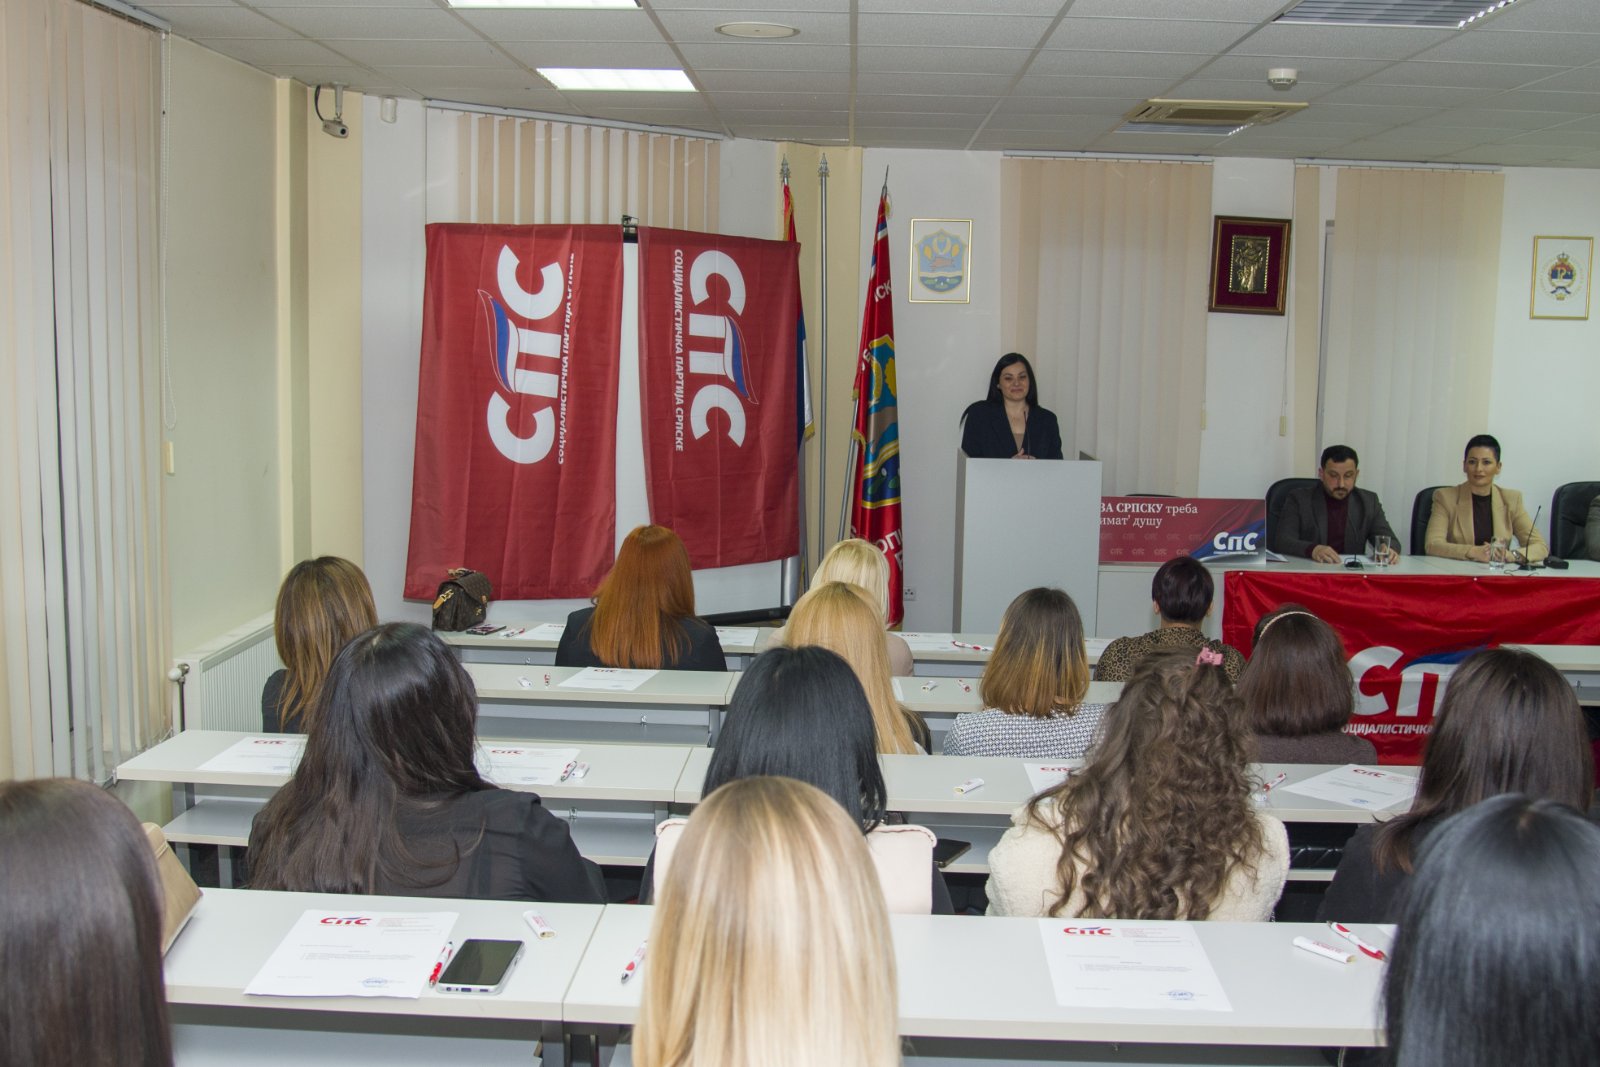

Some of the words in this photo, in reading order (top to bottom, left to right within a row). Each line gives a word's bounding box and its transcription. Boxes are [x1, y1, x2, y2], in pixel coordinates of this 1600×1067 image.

[673, 249, 684, 353] СОЦИЈАЛИСТИЧКА
[487, 244, 565, 464] СПС
[688, 250, 747, 447] СПС
[674, 356, 684, 405] ПАРТИЈА
[675, 407, 684, 451] СРПСКЕ
[1116, 502, 1164, 513] СРПСКУ
[1165, 503, 1198, 516] треба
[1133, 517, 1162, 529] душу
[1346, 646, 1461, 717] СП
